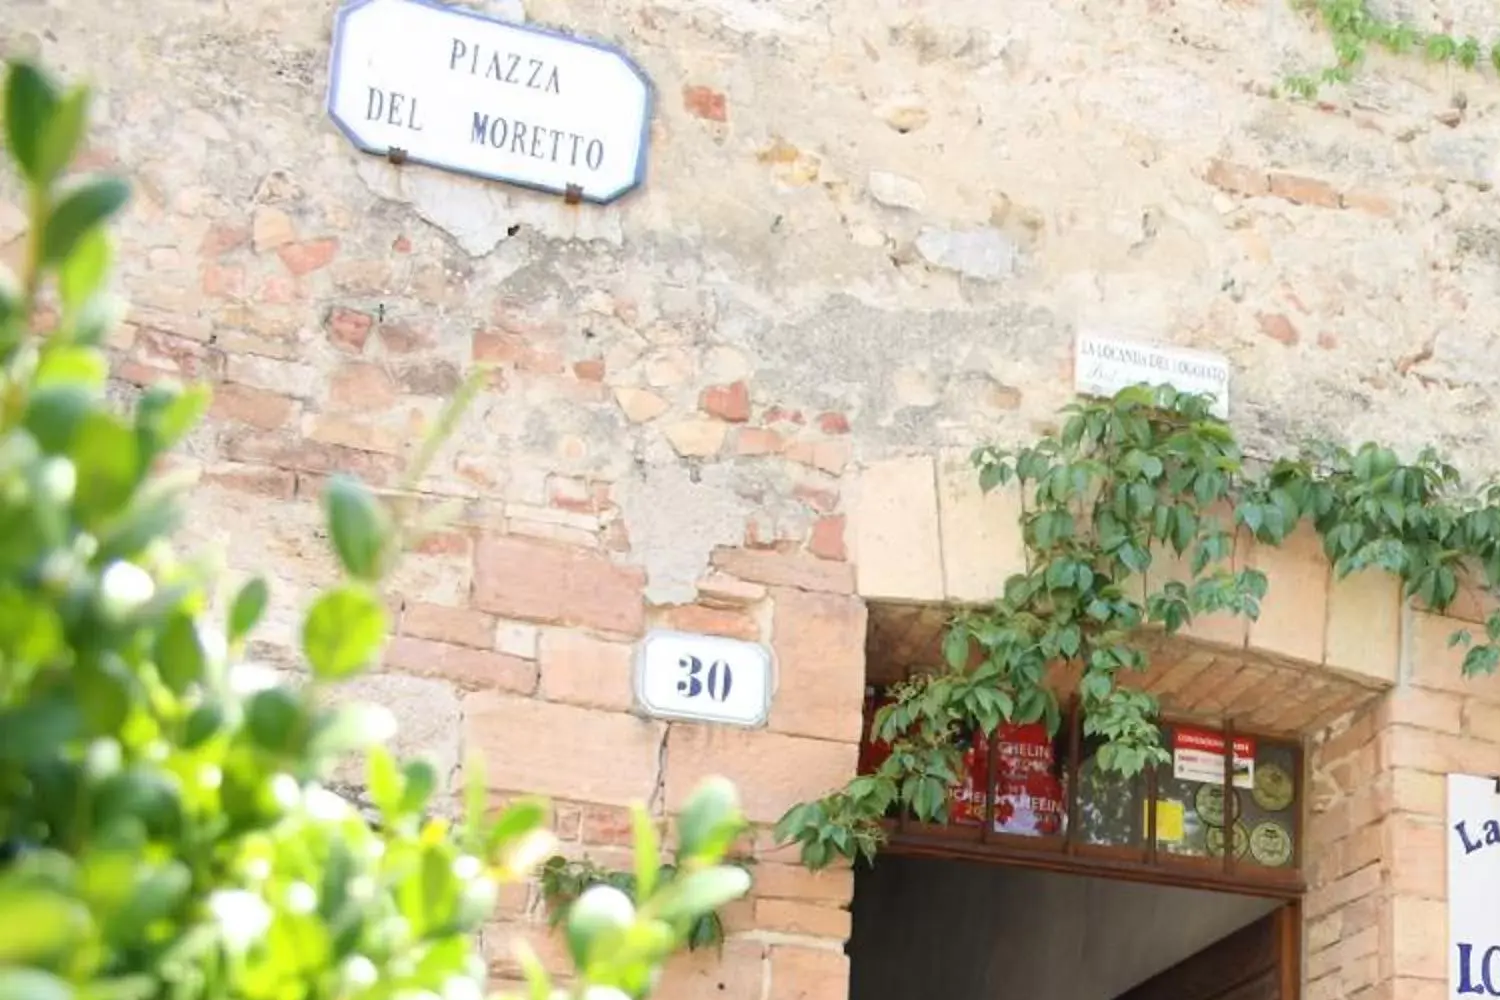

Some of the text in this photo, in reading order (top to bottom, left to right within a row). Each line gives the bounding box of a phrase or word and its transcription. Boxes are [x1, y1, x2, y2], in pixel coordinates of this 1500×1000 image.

[450, 37, 560, 95] PIAZZA
[366, 86, 605, 171] DEL MORETTO
[676, 653, 733, 703] 30
